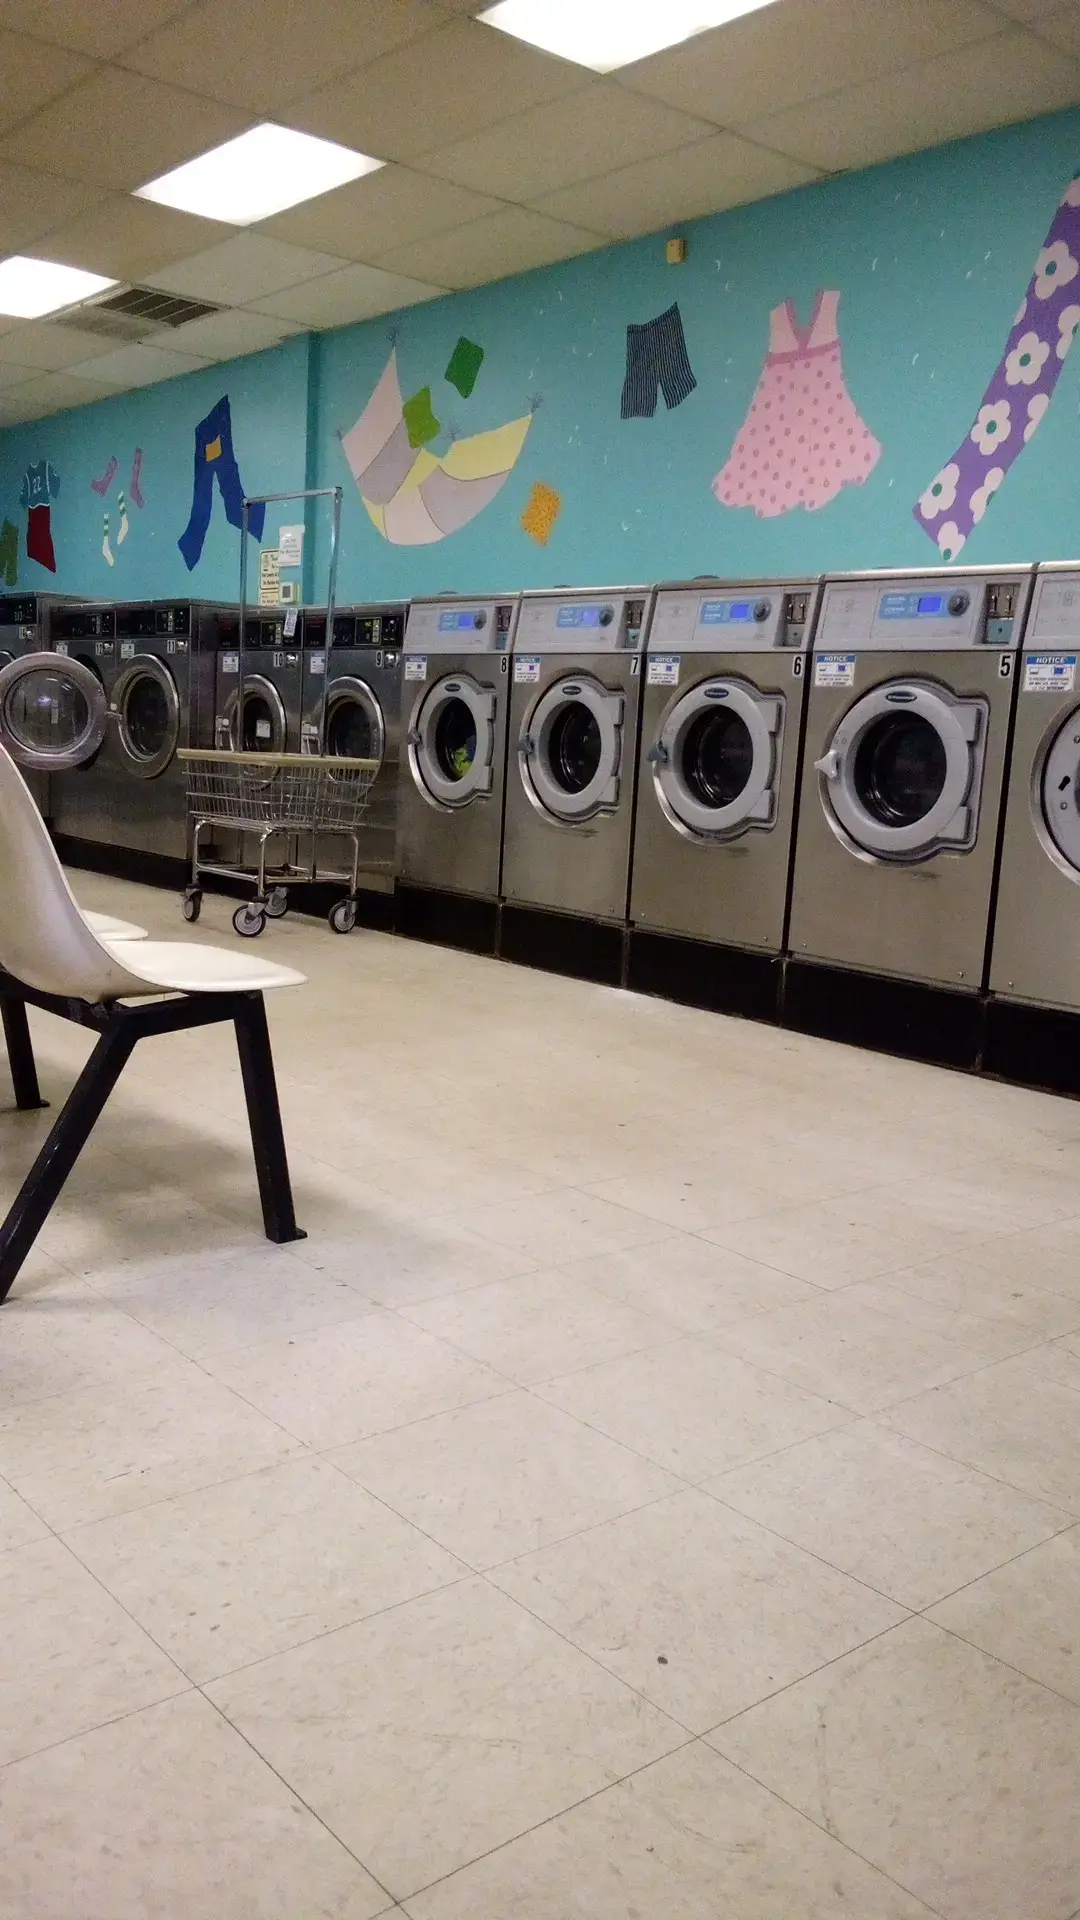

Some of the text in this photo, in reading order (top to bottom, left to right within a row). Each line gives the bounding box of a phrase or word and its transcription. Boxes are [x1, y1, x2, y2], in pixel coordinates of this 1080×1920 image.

[275, 652, 283, 666] 10
[376, 651, 382, 666] 9
[501, 657, 507, 673] 8
[632, 656, 639, 674] 7
[794, 656, 802, 675] 6
[1000, 655, 1011, 676] 5
[1036, 656, 1066, 664] NOTICE
